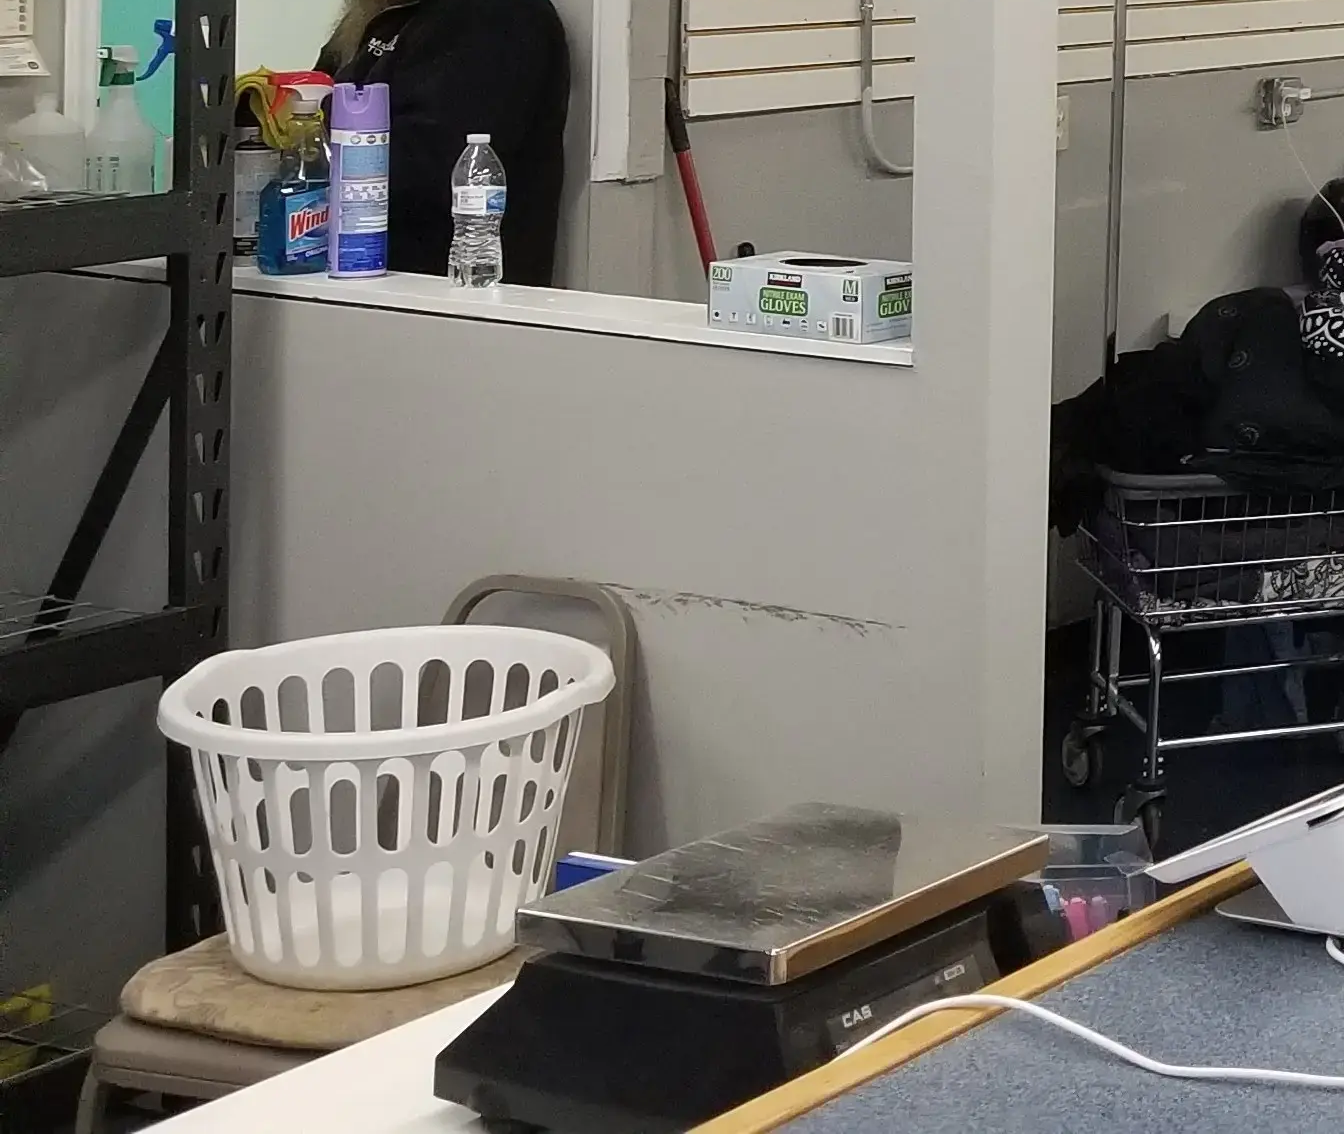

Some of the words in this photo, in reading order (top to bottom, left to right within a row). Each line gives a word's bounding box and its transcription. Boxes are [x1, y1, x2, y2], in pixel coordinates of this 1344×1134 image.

[290, 206, 329, 240] Wind
[713, 267, 731, 280] 200
[844, 280, 857, 295] M
[786, 291, 804, 301] EXAM
[760, 298, 806, 314] GLOVES
[880, 300, 910, 316] GLOV
[842, 1004, 873, 1028] CAS
